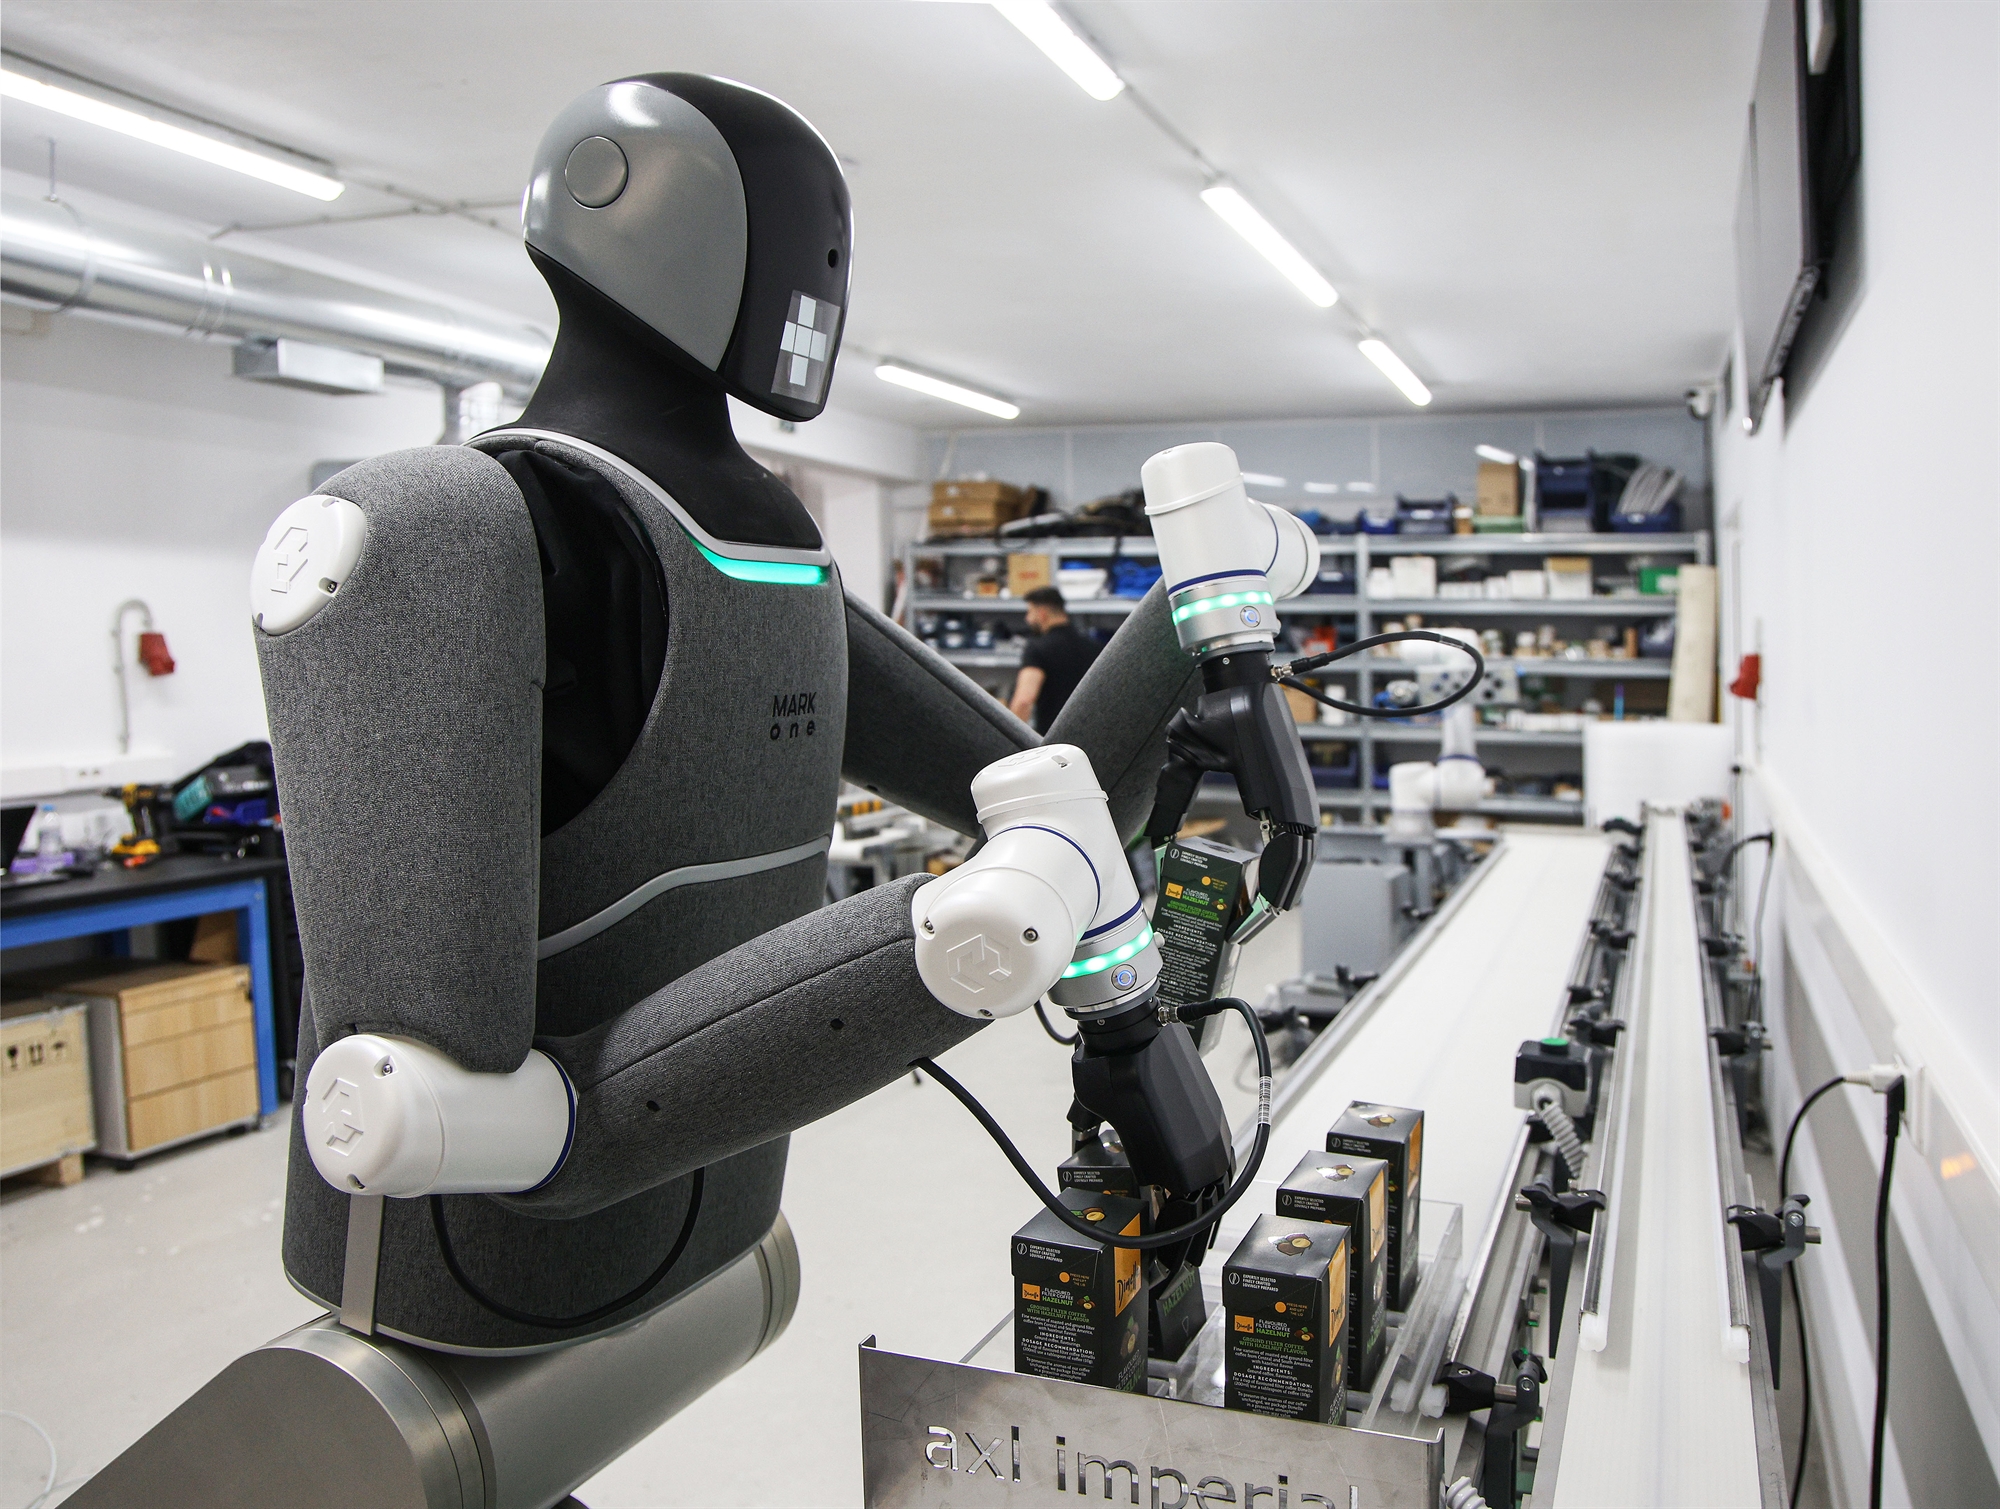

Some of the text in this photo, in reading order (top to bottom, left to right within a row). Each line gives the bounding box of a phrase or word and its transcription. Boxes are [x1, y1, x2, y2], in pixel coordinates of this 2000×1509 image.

[772, 692, 816, 717] MARK
[770, 720, 816, 740] one
[1182, 895, 1209, 906] HAZELNUT
[1162, 1270, 1195, 1316] HAZELNUT
[1042, 1296, 1073, 1306] HAZELNUT
[1041, 1310, 1066, 1319] HAZELNUT
[1068, 1315, 1090, 1324] FLAVOUR
[1256, 1328, 1290, 1338] HAZELNUT
[1255, 1343, 1282, 1351] HAZELNUT
[1253, 1365, 1292, 1374] INGREDIENTS:
[1258, 1376, 1312, 1388] RECOMMENDATION:
[925, 1426, 1020, 1483] axl
